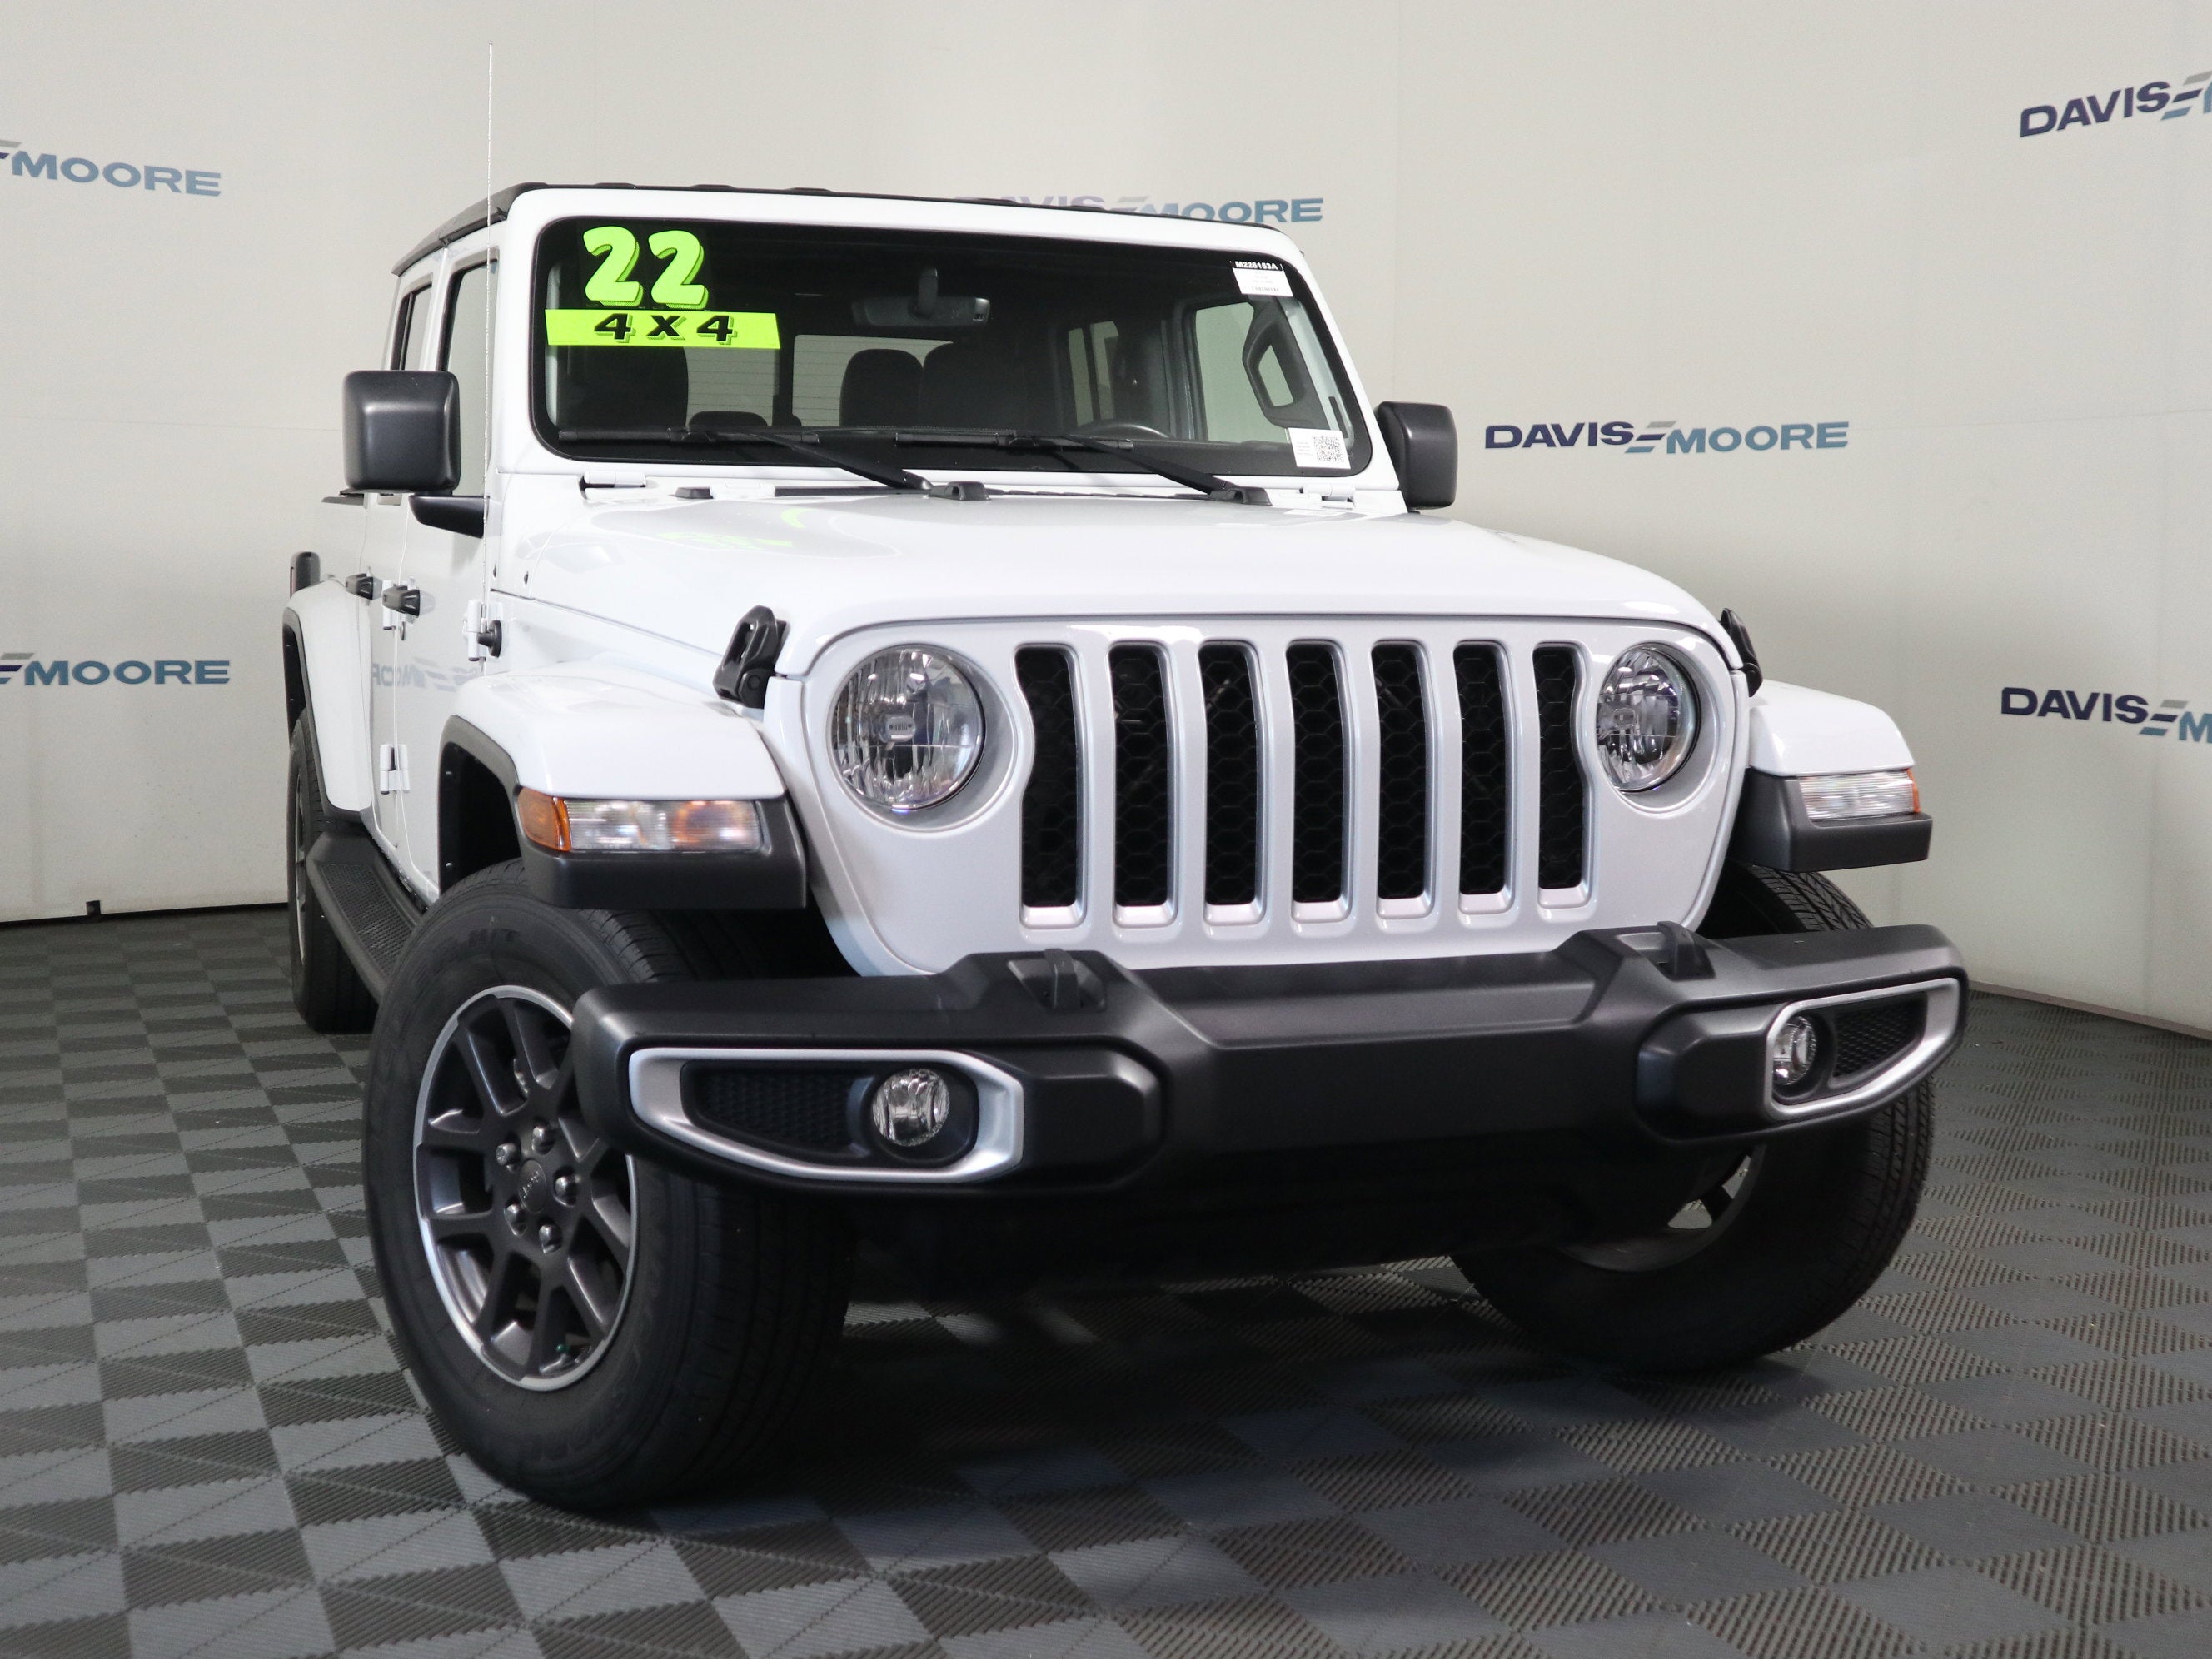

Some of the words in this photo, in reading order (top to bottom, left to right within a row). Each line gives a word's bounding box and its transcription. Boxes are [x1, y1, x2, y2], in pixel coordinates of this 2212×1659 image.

[2020, 81, 2171, 137] DAVIS
[11, 150, 222, 197] MOORE
[583, 226, 708, 310] 22
[1485, 421, 1634, 449] DAVIS
[1666, 421, 1850, 455] MOORE
[24, 660, 231, 686] MOORE
[2000, 686, 2149, 725] DAVIS
